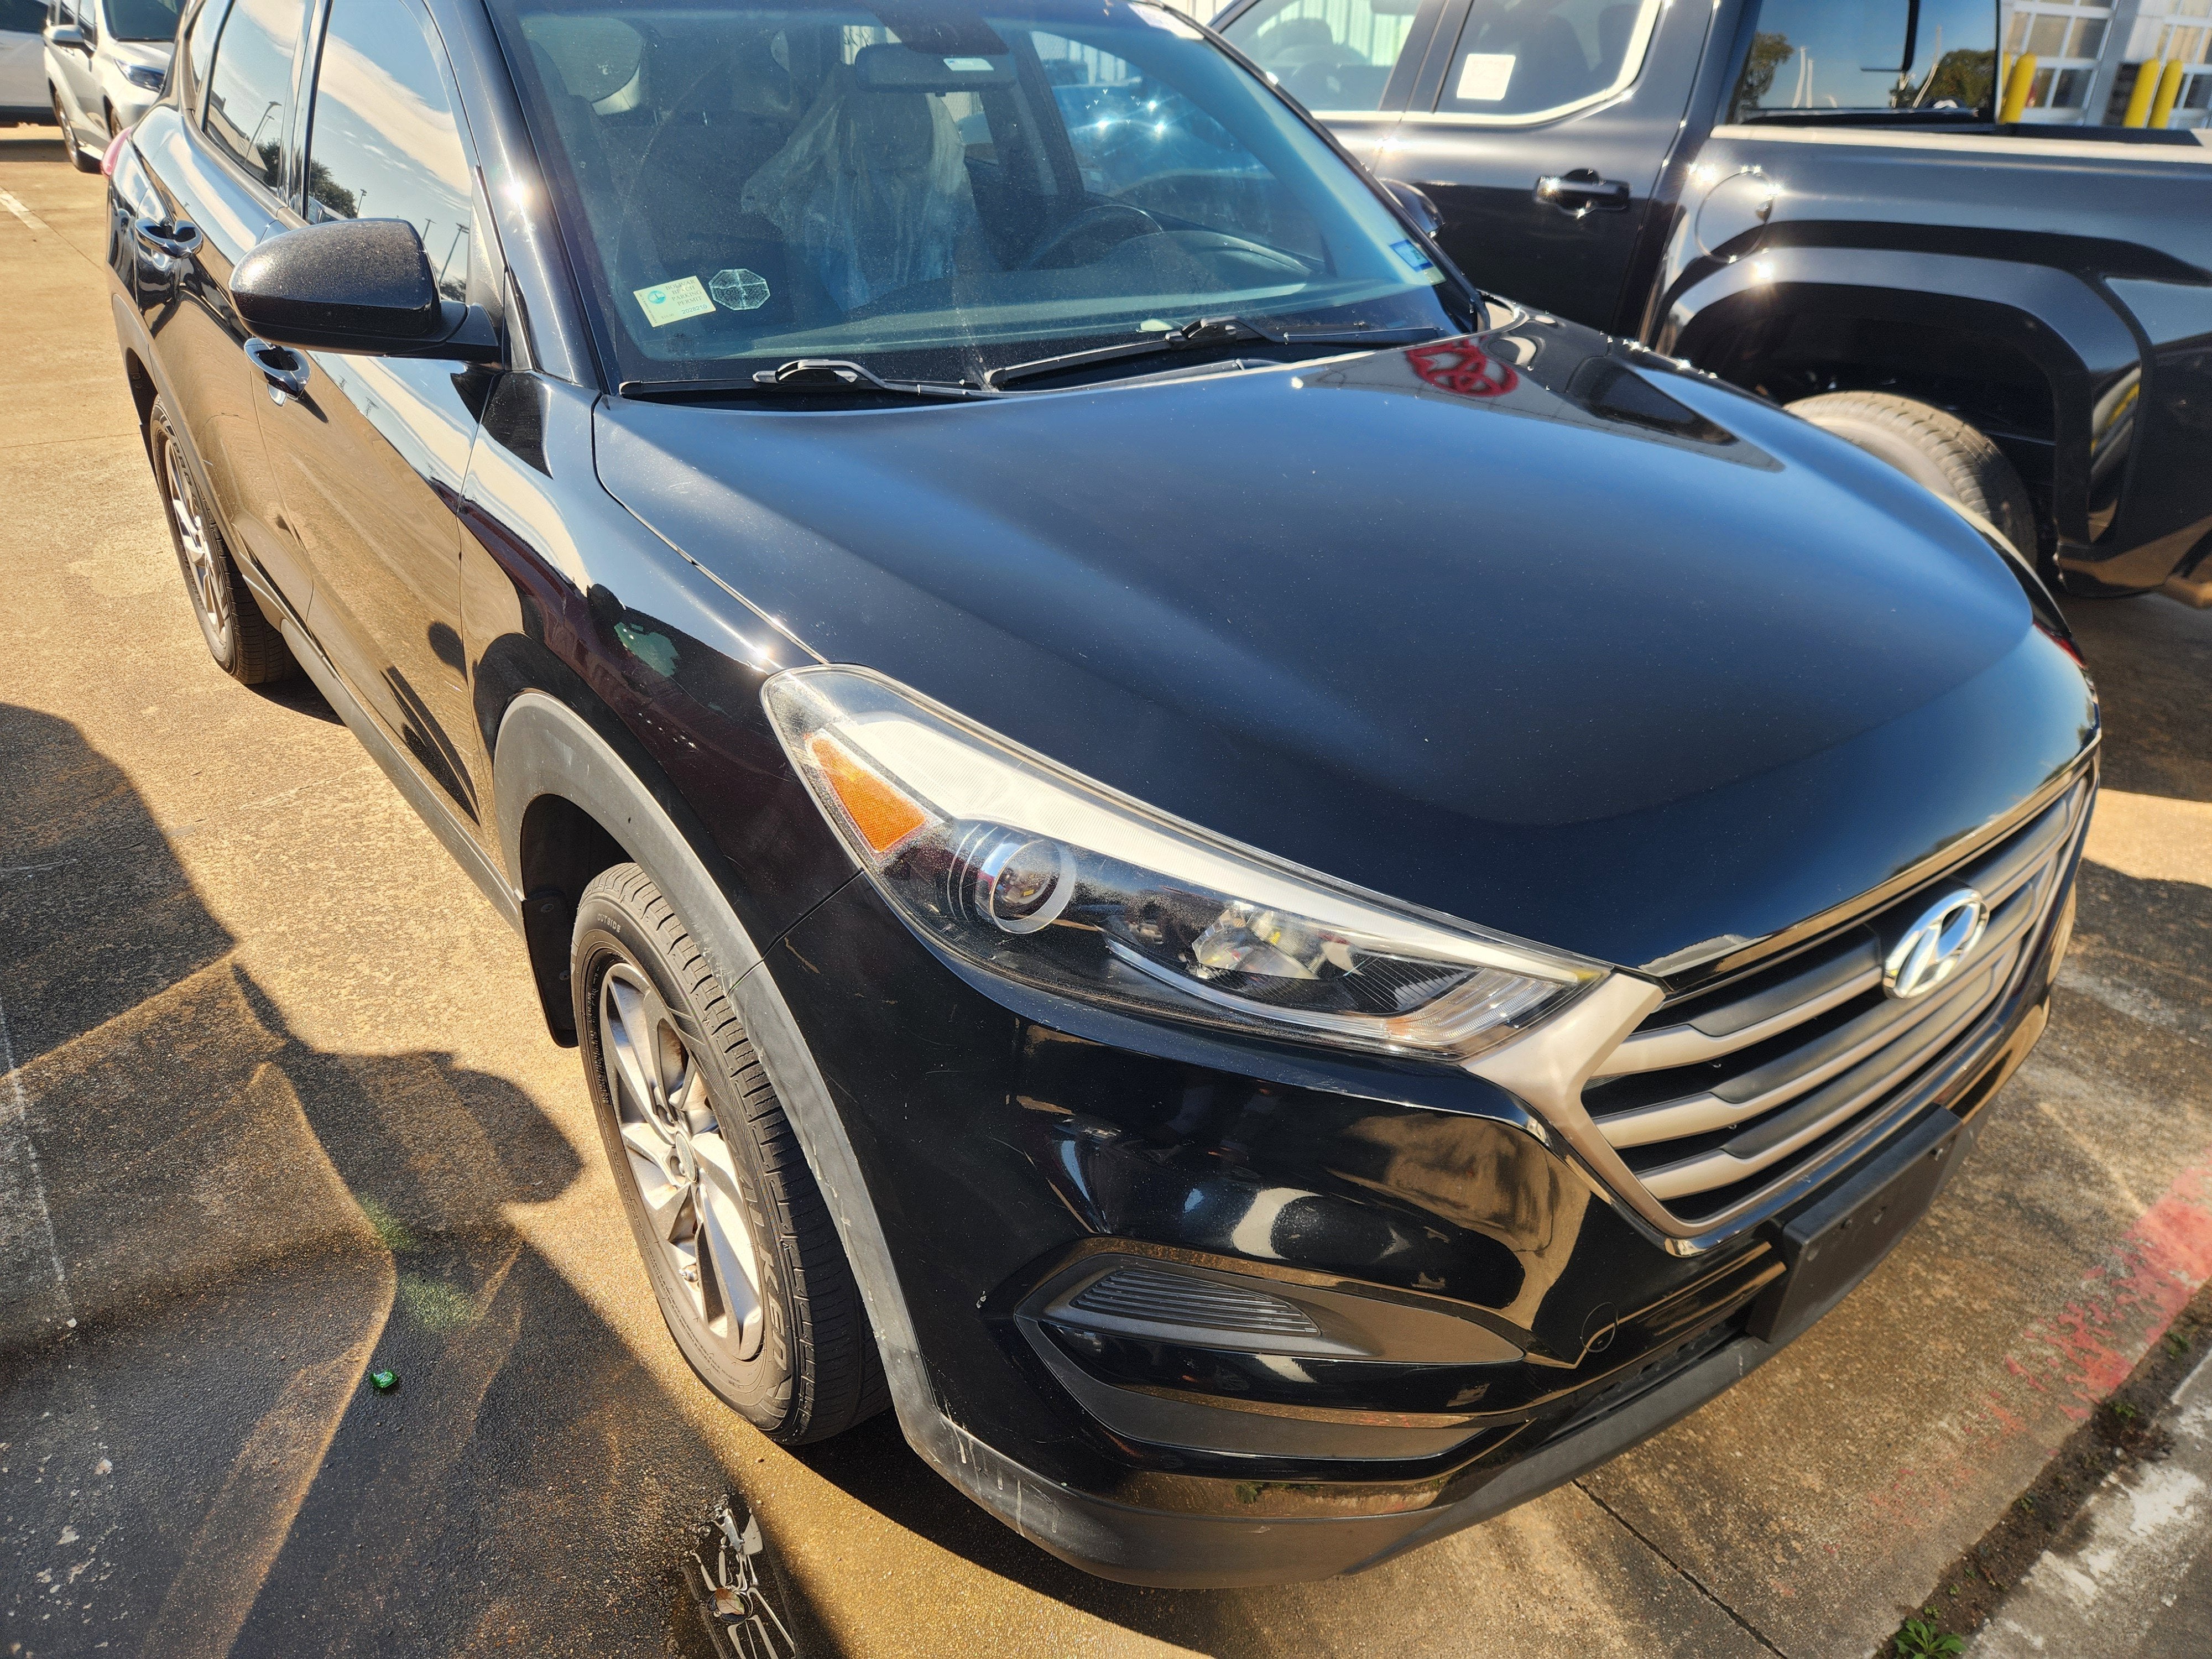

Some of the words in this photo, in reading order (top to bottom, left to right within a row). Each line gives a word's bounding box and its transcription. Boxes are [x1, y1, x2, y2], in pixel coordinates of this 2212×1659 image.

[665, 280, 696, 290] BOLIVAR
[672, 285, 695, 295] BEACH
[671, 290, 702, 301] PARKING
[677, 296, 702, 306] PERMIT
[681, 304, 707, 315] 2028210
[597, 913, 621, 933] OUTSIDE
